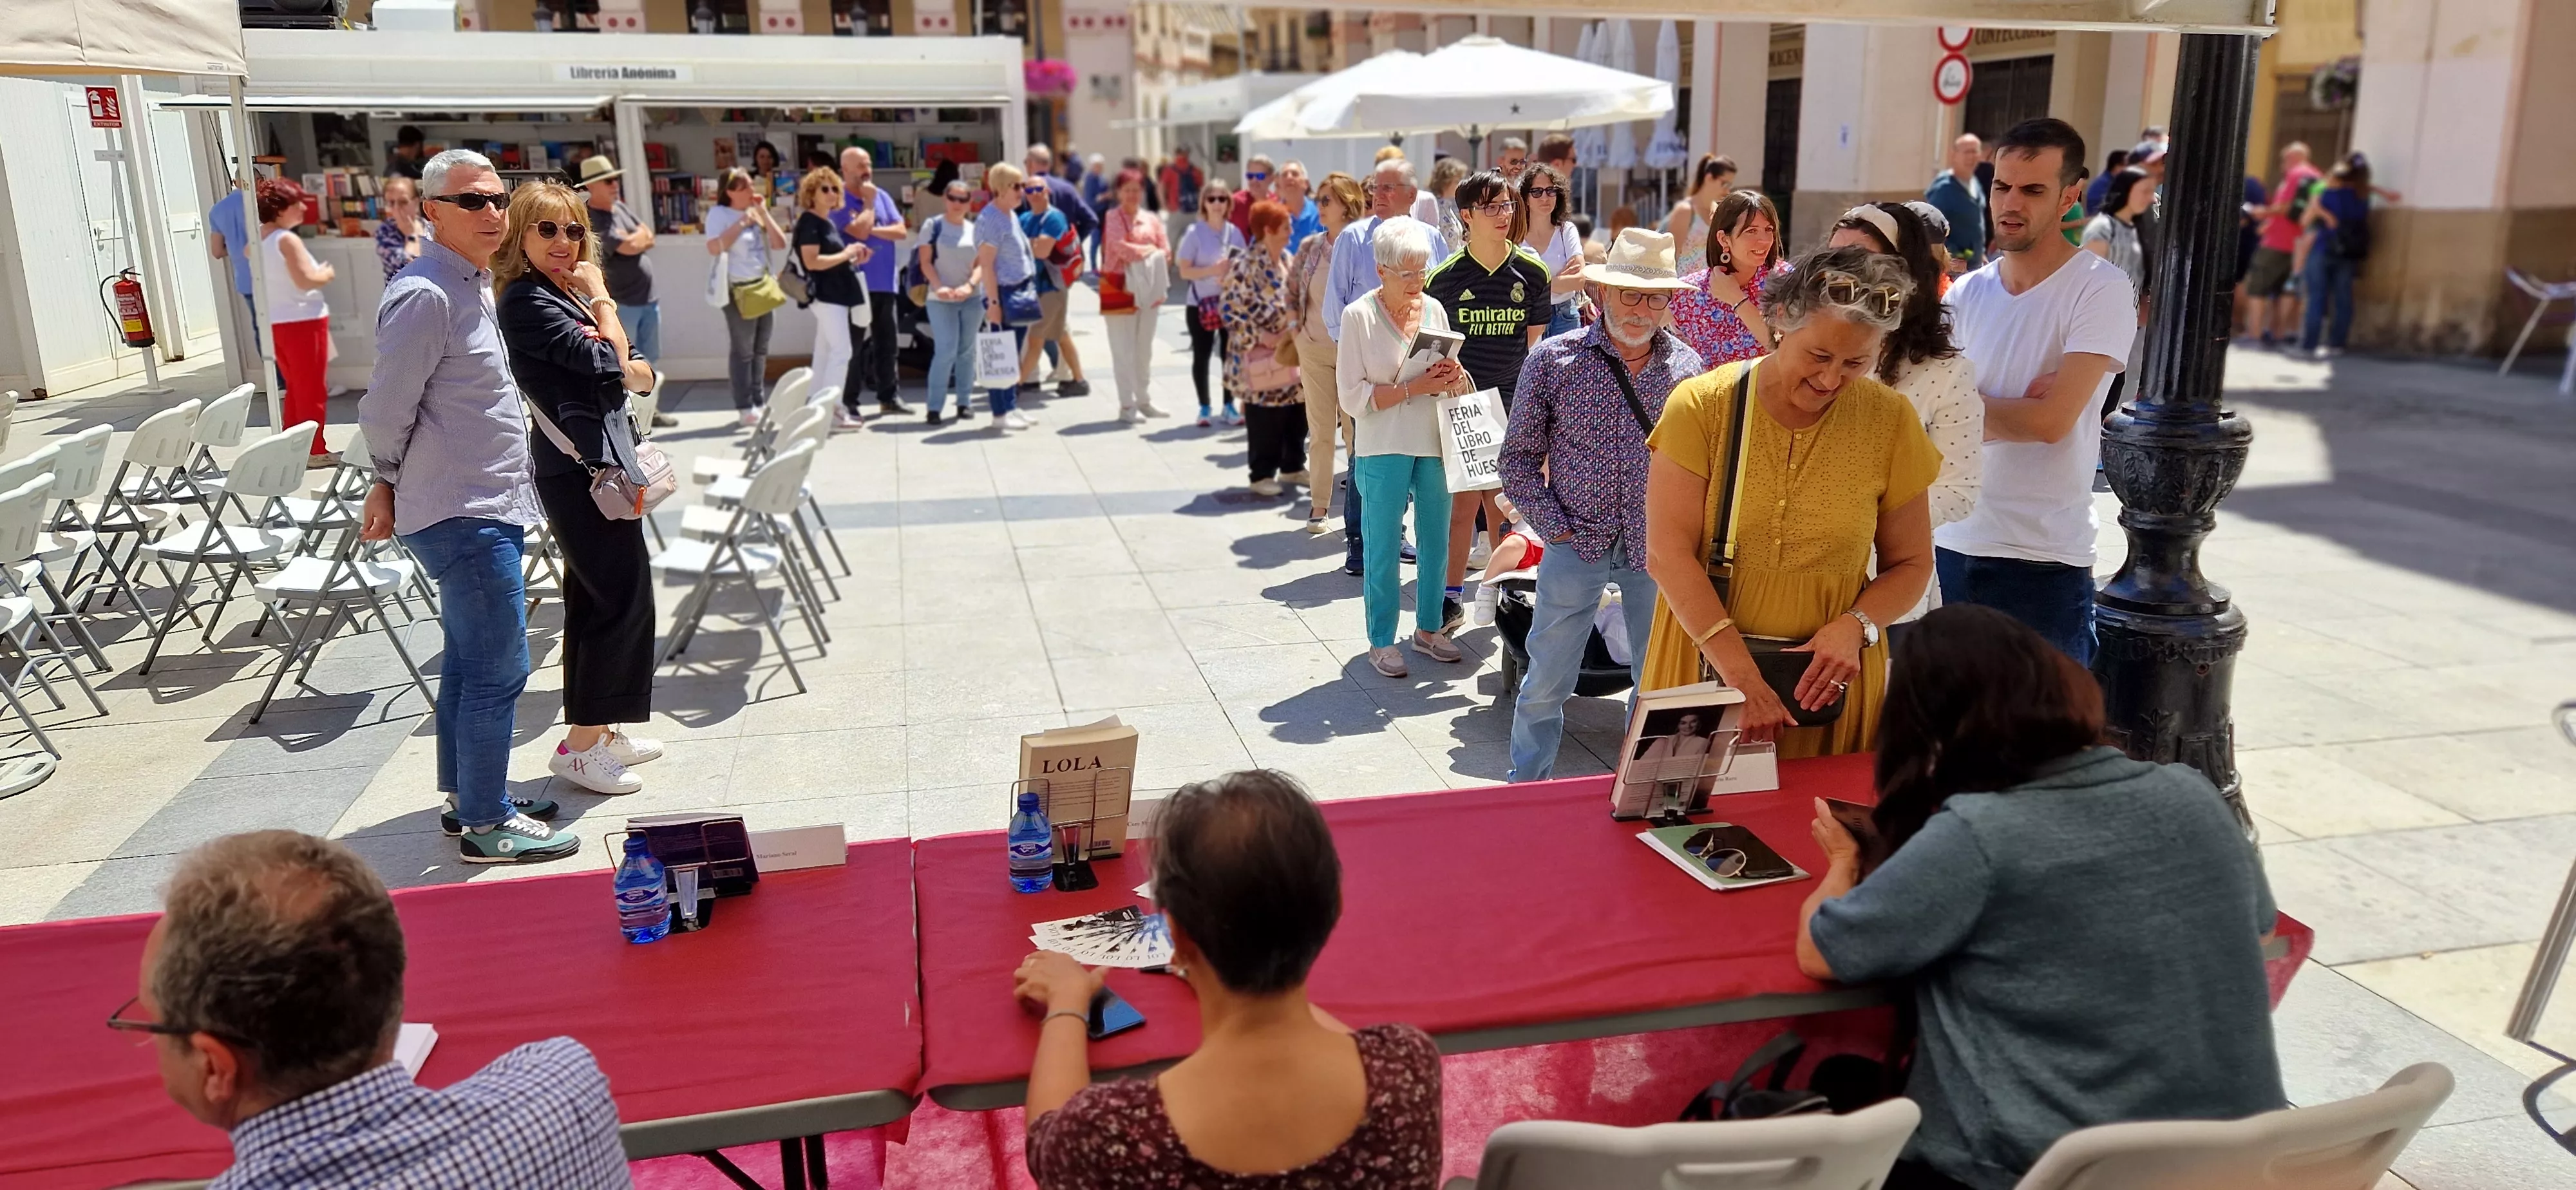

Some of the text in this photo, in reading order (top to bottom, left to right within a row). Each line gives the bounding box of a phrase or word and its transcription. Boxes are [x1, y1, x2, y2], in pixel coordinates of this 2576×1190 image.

[1459, 305, 1526, 323] Emirates
[1469, 322, 1515, 335] FLY BETTER
[1448, 404, 1482, 422] FERIA
[1452, 420, 1475, 436] DEL
[1457, 431, 1492, 450] LIBRO
[1462, 449, 1478, 464] DE
[1466, 458, 1497, 478] HUES
[567, 757, 589, 775] AX
[1042, 755, 1103, 774] LOLA
